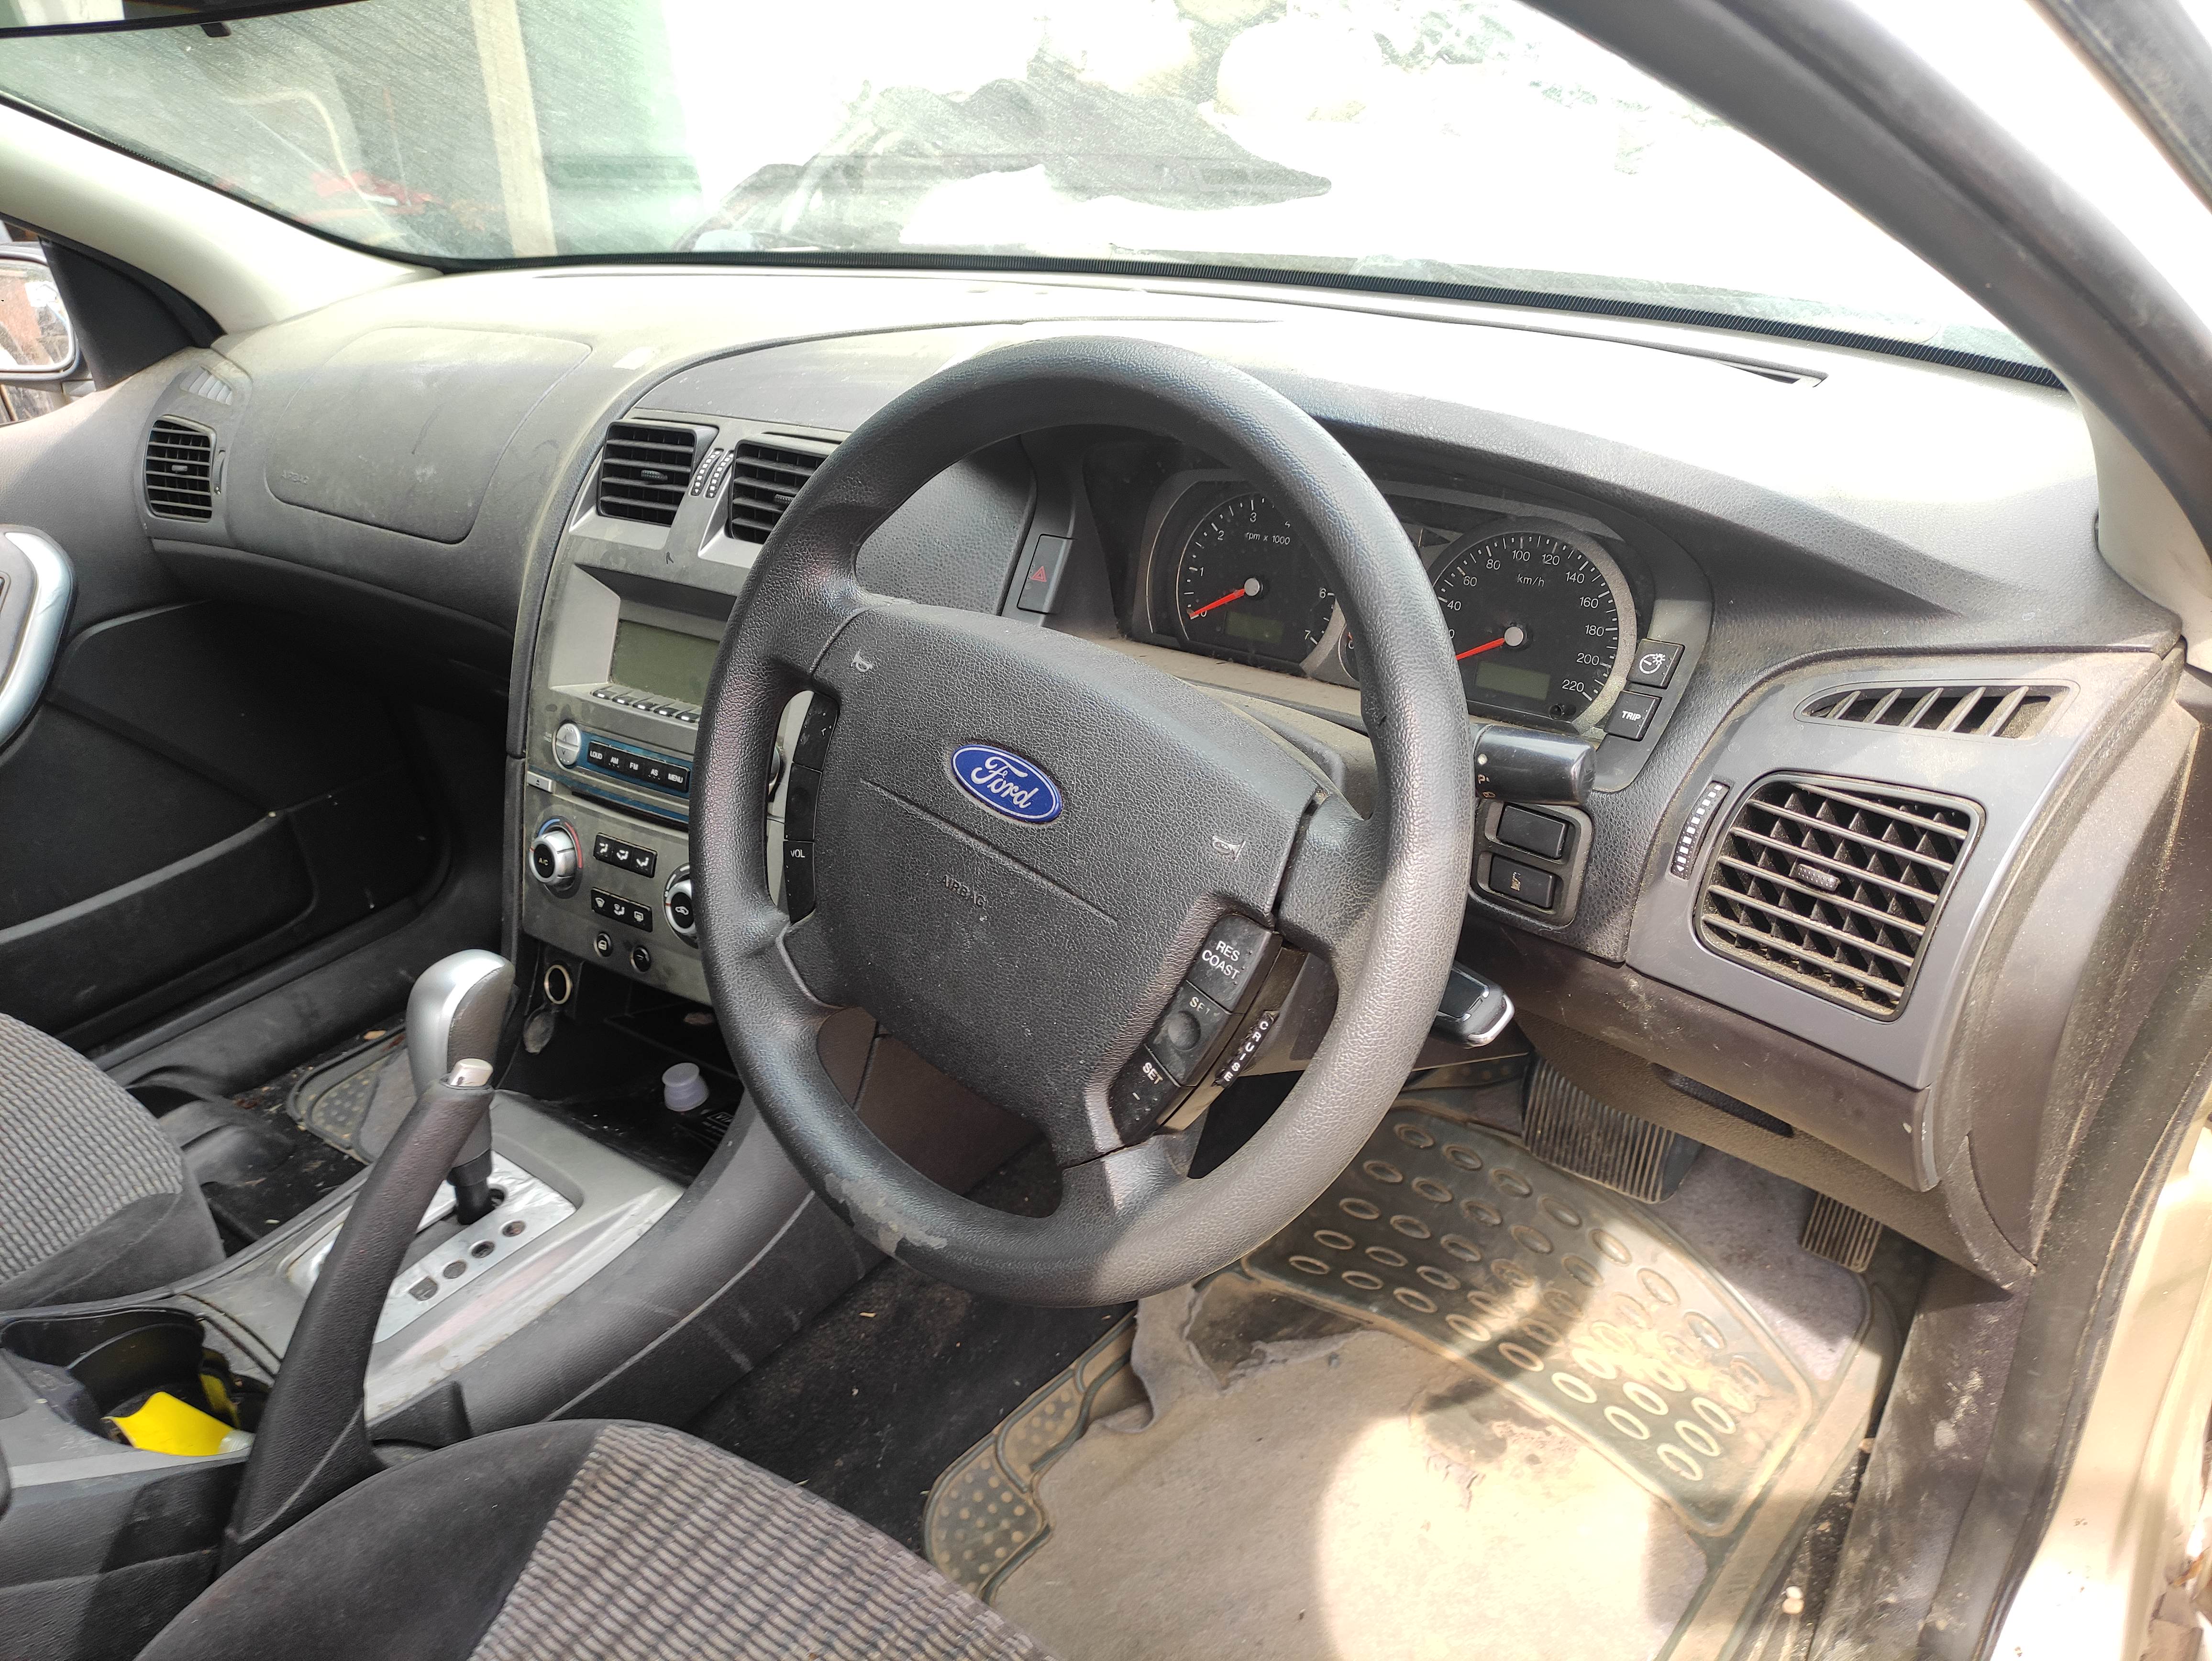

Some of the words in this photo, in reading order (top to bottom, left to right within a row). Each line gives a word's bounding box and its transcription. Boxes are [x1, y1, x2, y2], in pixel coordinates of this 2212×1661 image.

[1250, 512, 1257, 522] 3
[1217, 531, 1225, 541] 2
[1246, 532, 1260, 541] rpm
[1272, 536, 1291, 545] 1000
[1512, 550, 1530, 562] 100
[1542, 554, 1560, 565] 120
[1486, 559, 1501, 571] 80
[1199, 567, 1204, 576] 1
[1566, 571, 1585, 584] 140
[1463, 576, 1477, 587] 60
[1517, 574, 1545, 587] km/h
[1319, 588, 1327, 598] 6
[1447, 600, 1461, 611] 40
[1580, 596, 1599, 609] 160
[1305, 630, 1311, 639] 7
[1449, 629, 1455, 639] 0
[1585, 624, 1604, 637] 180
[1576, 653, 1600, 666] 200
[1561, 679, 1584, 692] 220
[1622, 710, 1641, 721] TRIP
[589, 750, 603, 760] LOUD
[610, 756, 619, 765] AM
[630, 762, 639, 771] FM
[650, 768, 659, 776] AS
[668, 773, 684, 784] MENU
[970, 756, 1039, 809] Ford
[790, 849, 806, 858] VOL
[1216, 940, 1240, 962] RES
[1201, 950, 1240, 981] COAST
[1223, 1020, 1269, 1082] CRUISE
[1142, 1062, 1163, 1085] SET
